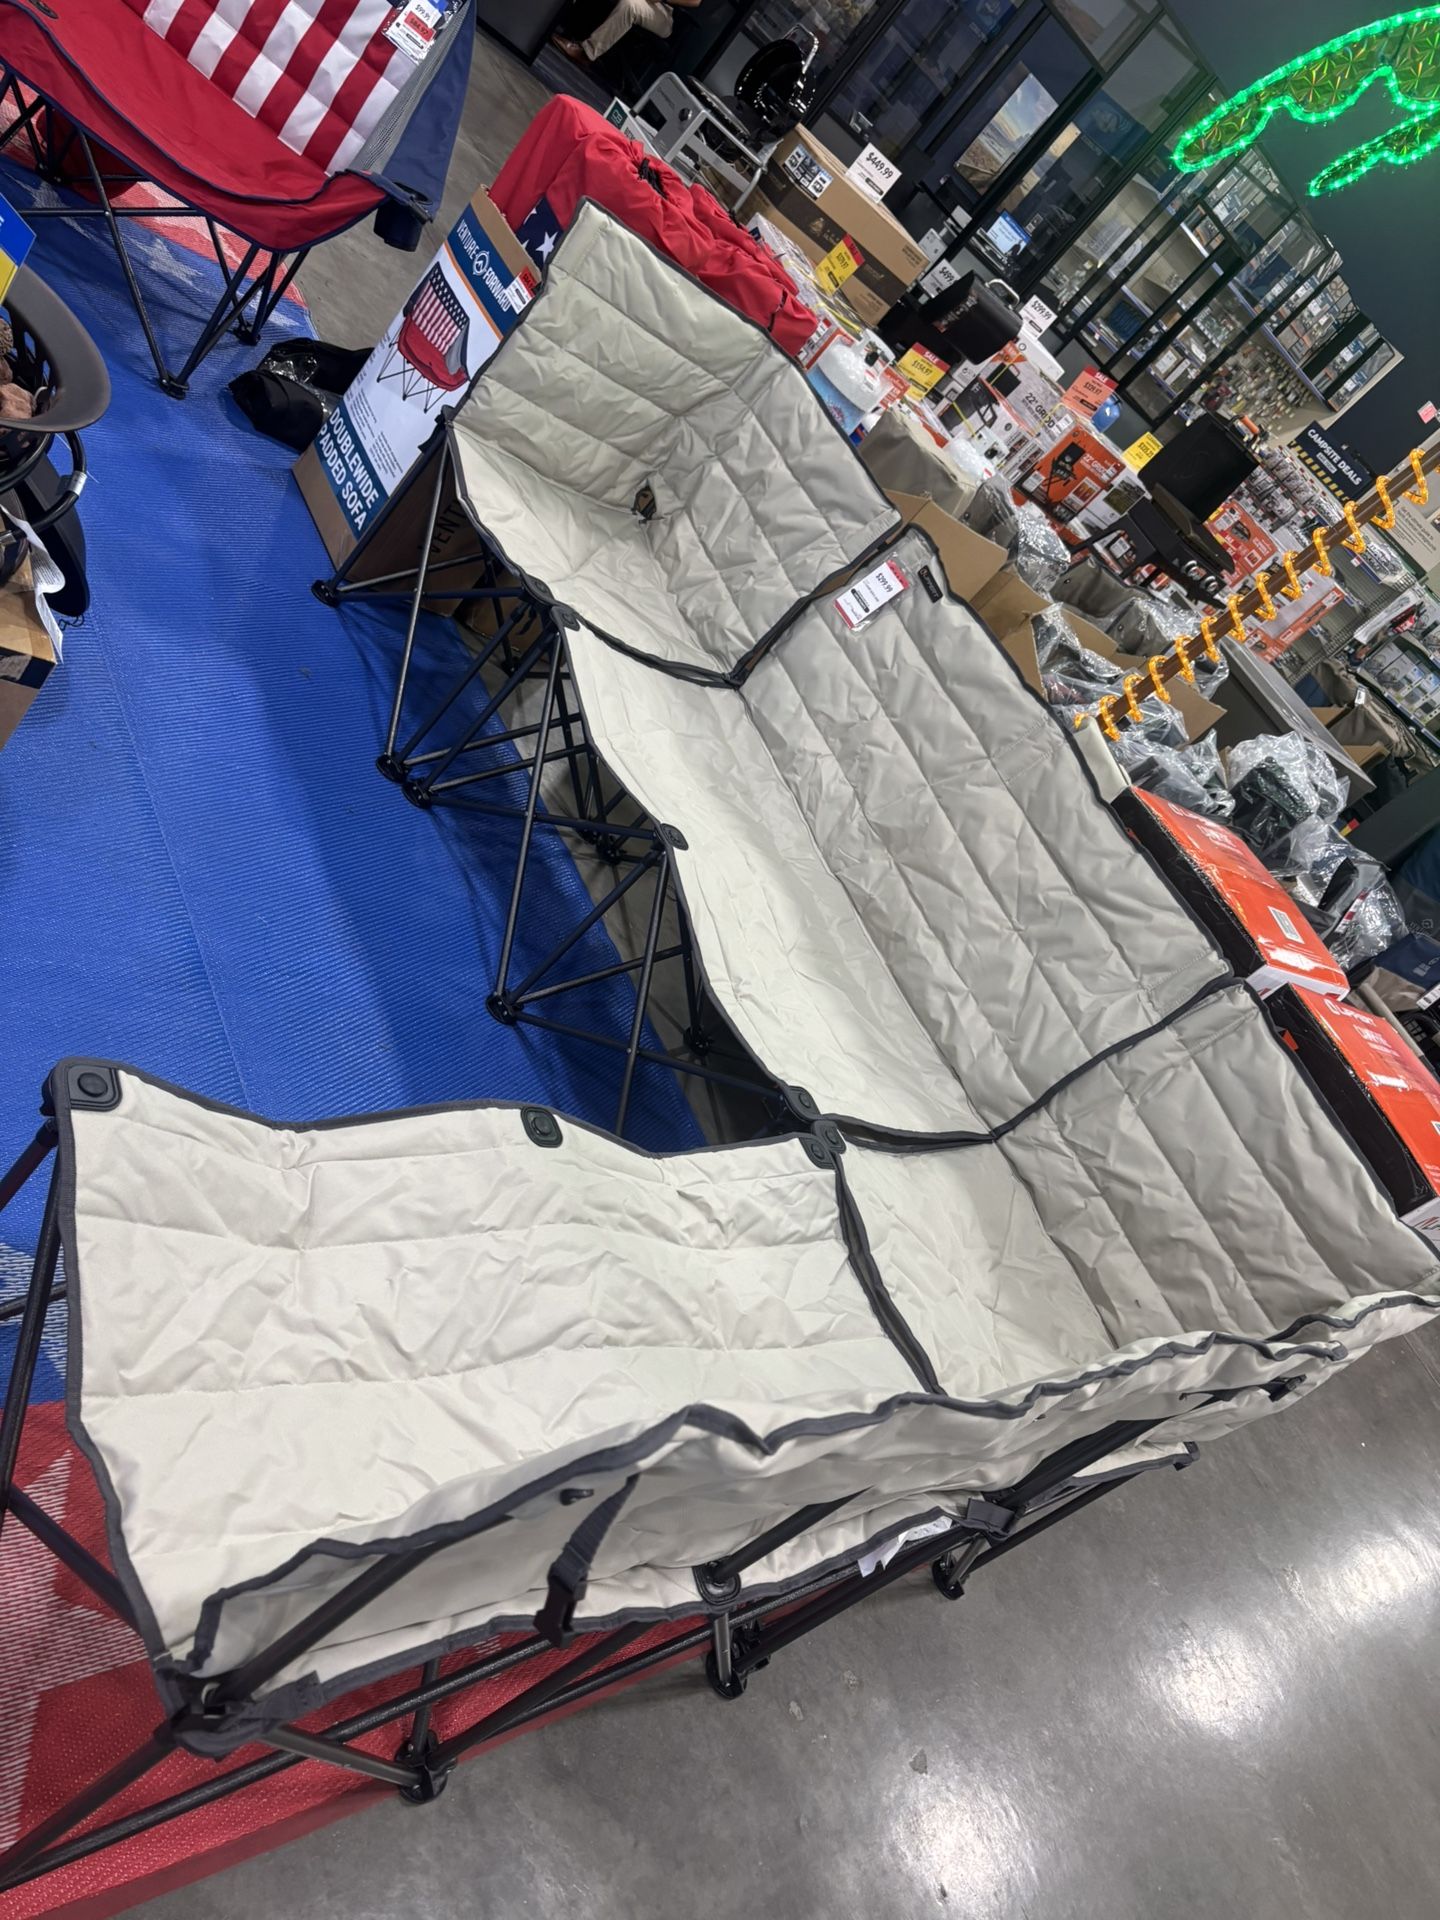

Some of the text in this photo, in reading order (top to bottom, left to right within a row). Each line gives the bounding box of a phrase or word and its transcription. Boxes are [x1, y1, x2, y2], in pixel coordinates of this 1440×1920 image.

[865, 151, 894, 179] $449.99
[455, 220, 511, 312] VENTURE FORWARD
[1031, 300, 1053, 321] $299.99
[923, 351, 939, 364] SALE
[1095, 371, 1108, 383] SALE
[317, 425, 365, 530] PADDED SOFA
[330, 407, 379, 509] DOUBLEWIDE
[1307, 428, 1362, 486] CAMPSITE DEALS
